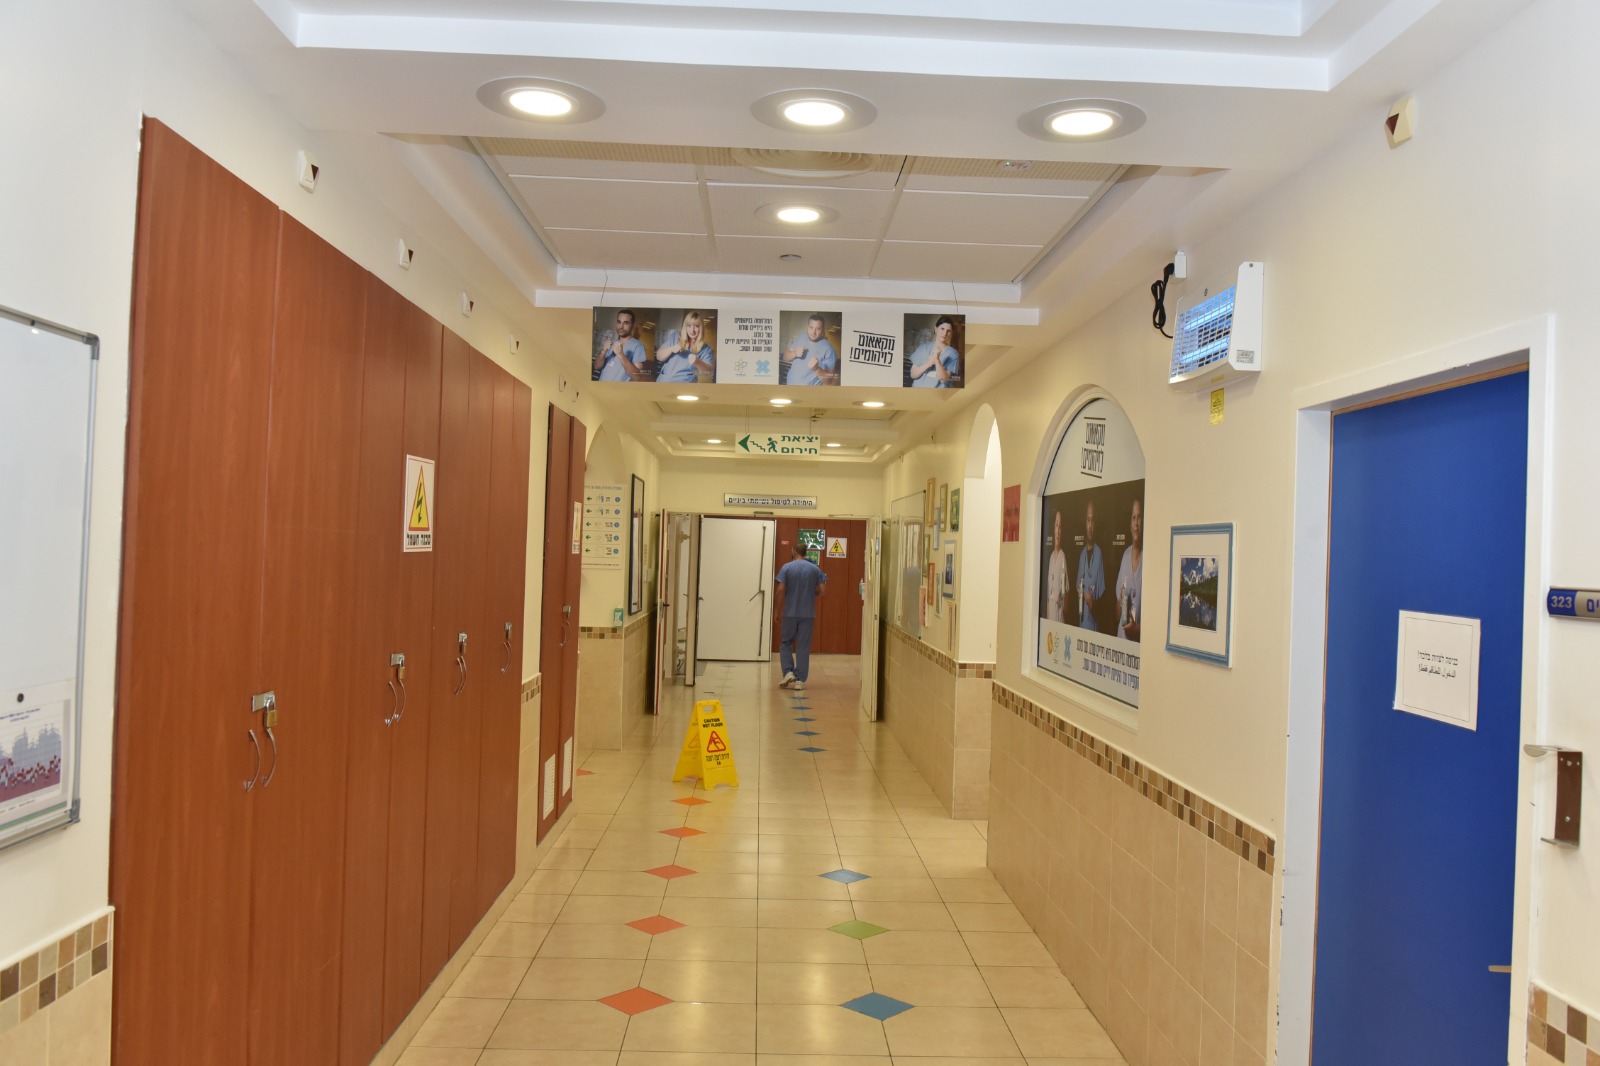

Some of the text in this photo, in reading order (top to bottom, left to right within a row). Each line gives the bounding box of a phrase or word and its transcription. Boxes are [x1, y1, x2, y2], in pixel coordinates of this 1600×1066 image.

[858, 334, 896, 351] נוקאאוט
[849, 346, 894, 365] לזיהומים!
[781, 435, 819, 443] יציאת
[1085, 422, 1106, 449] נוקאאוט
[781, 446, 818, 455] חירום
[747, 497, 769, 505] נשימתי
[771, 497, 791, 506] לטיפול
[1551, 595, 1572, 609] 323
[1417, 650, 1458, 666] כניסה לצוות בלבד!
